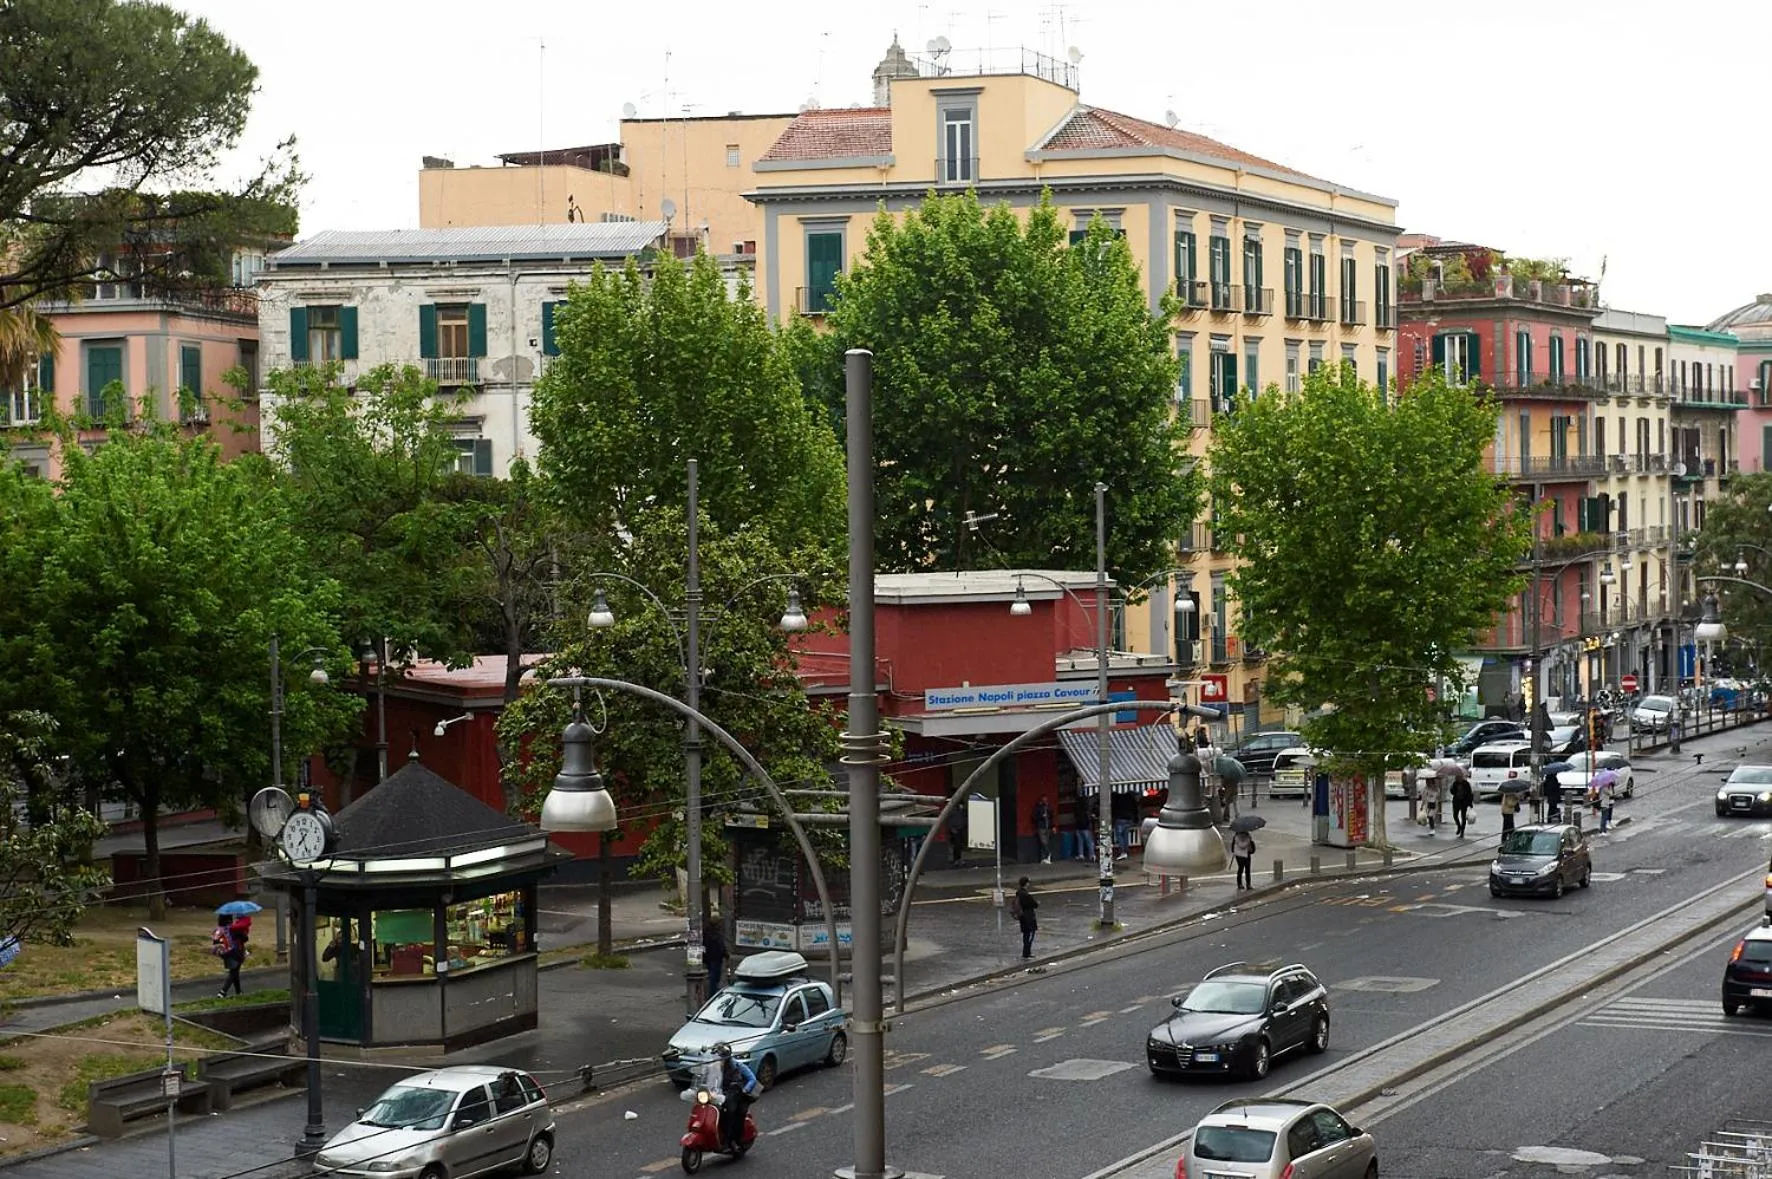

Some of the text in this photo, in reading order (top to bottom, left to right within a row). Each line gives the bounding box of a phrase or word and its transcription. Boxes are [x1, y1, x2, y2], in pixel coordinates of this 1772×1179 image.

[928, 687, 1090, 705] Stazione Napoli piazza Cavour
